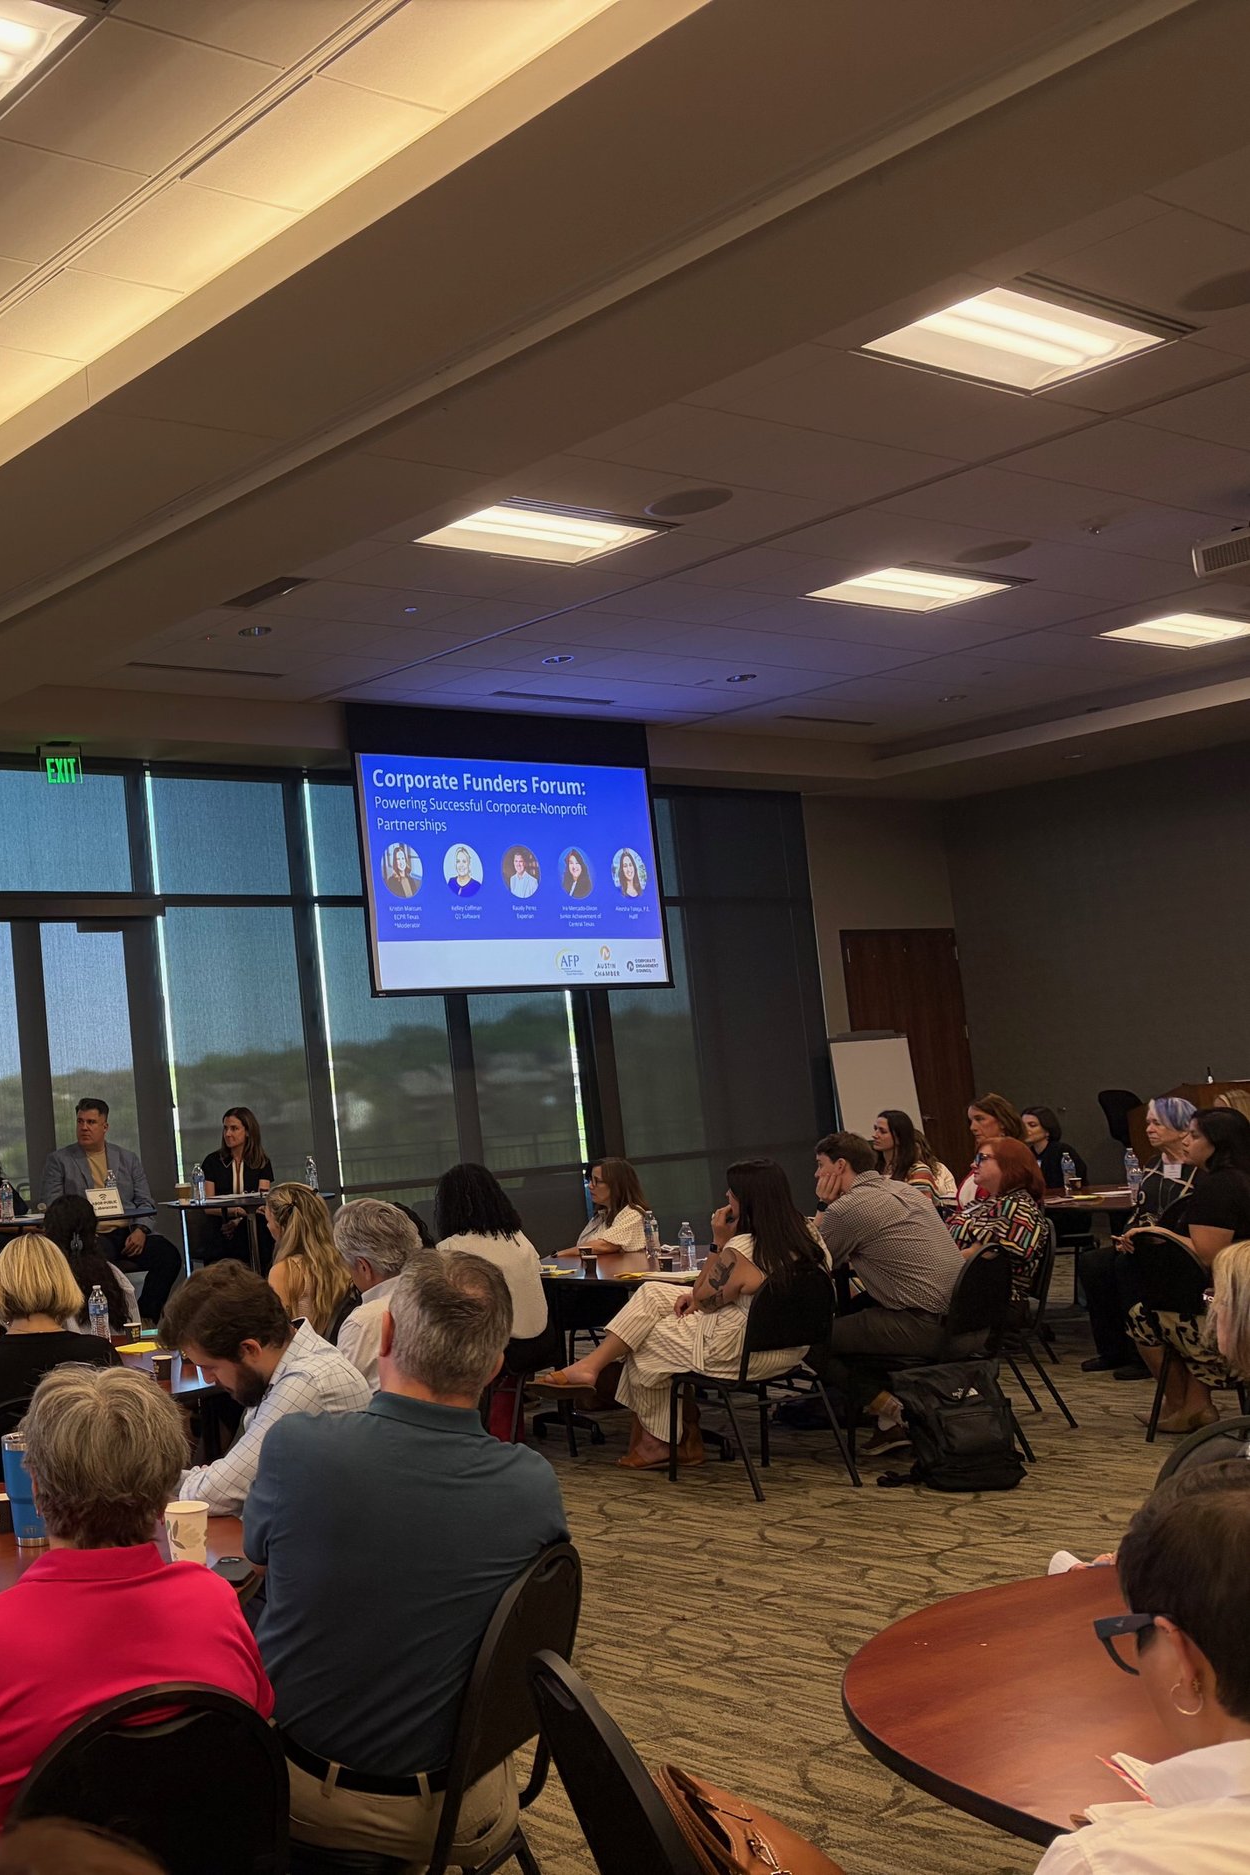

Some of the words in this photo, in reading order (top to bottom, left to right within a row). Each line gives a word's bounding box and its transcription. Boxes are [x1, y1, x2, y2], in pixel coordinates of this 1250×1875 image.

[45, 758, 76, 784] EXIT
[372, 769, 458, 793] Corporate
[463, 773, 528, 793] Funders
[531, 776, 586, 796] Forum:
[374, 796, 428, 813] Powering
[429, 797, 483, 812] Successful
[485, 799, 588, 818] Corporate-Nonprofit
[377, 817, 447, 835] Partnerships
[560, 954, 580, 968] AFP
